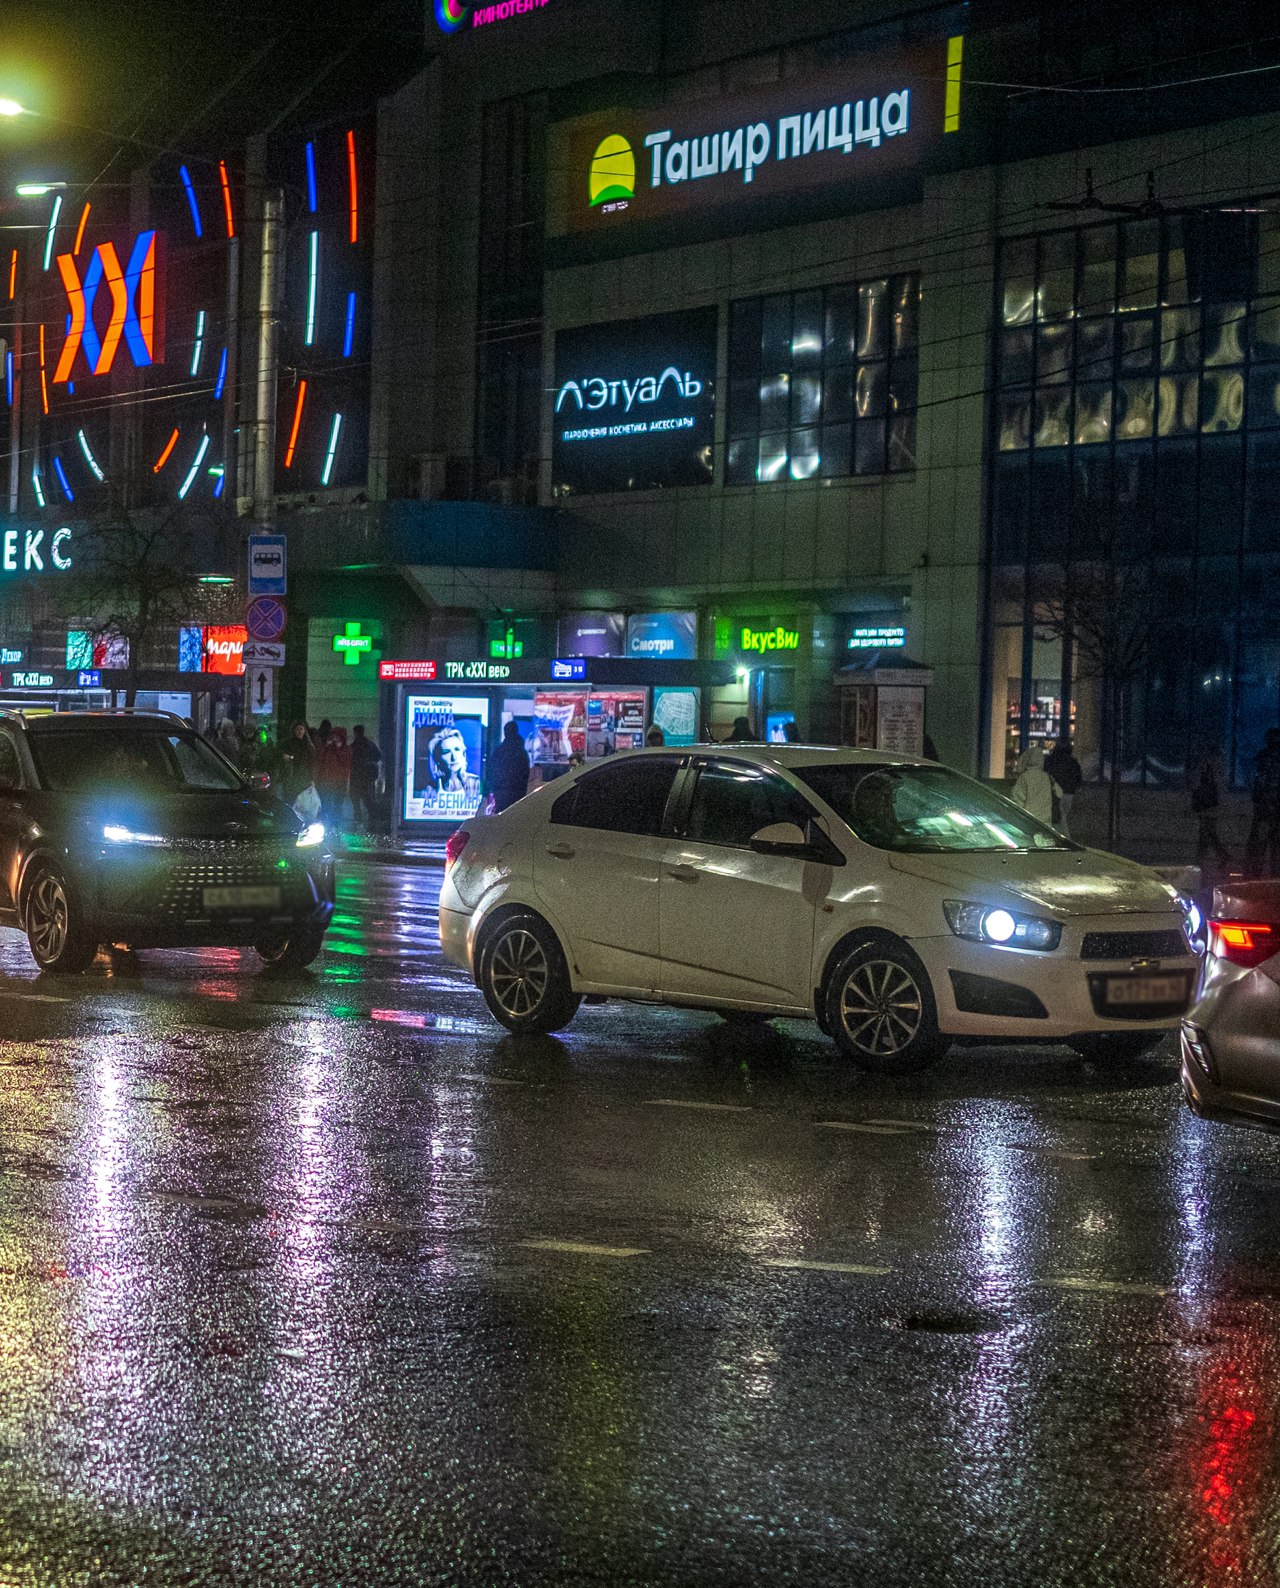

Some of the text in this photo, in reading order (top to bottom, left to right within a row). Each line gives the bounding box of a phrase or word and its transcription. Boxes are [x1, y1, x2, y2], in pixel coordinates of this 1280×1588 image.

[644, 88, 911, 187] Ташир пицца
[631, 638, 674, 654] Смотри
[446, 661, 465, 678] ТРК
[466, 661, 487, 678] «XXI
[488, 665, 510, 678] век»
[413, 706, 455, 728] ДИАНА
